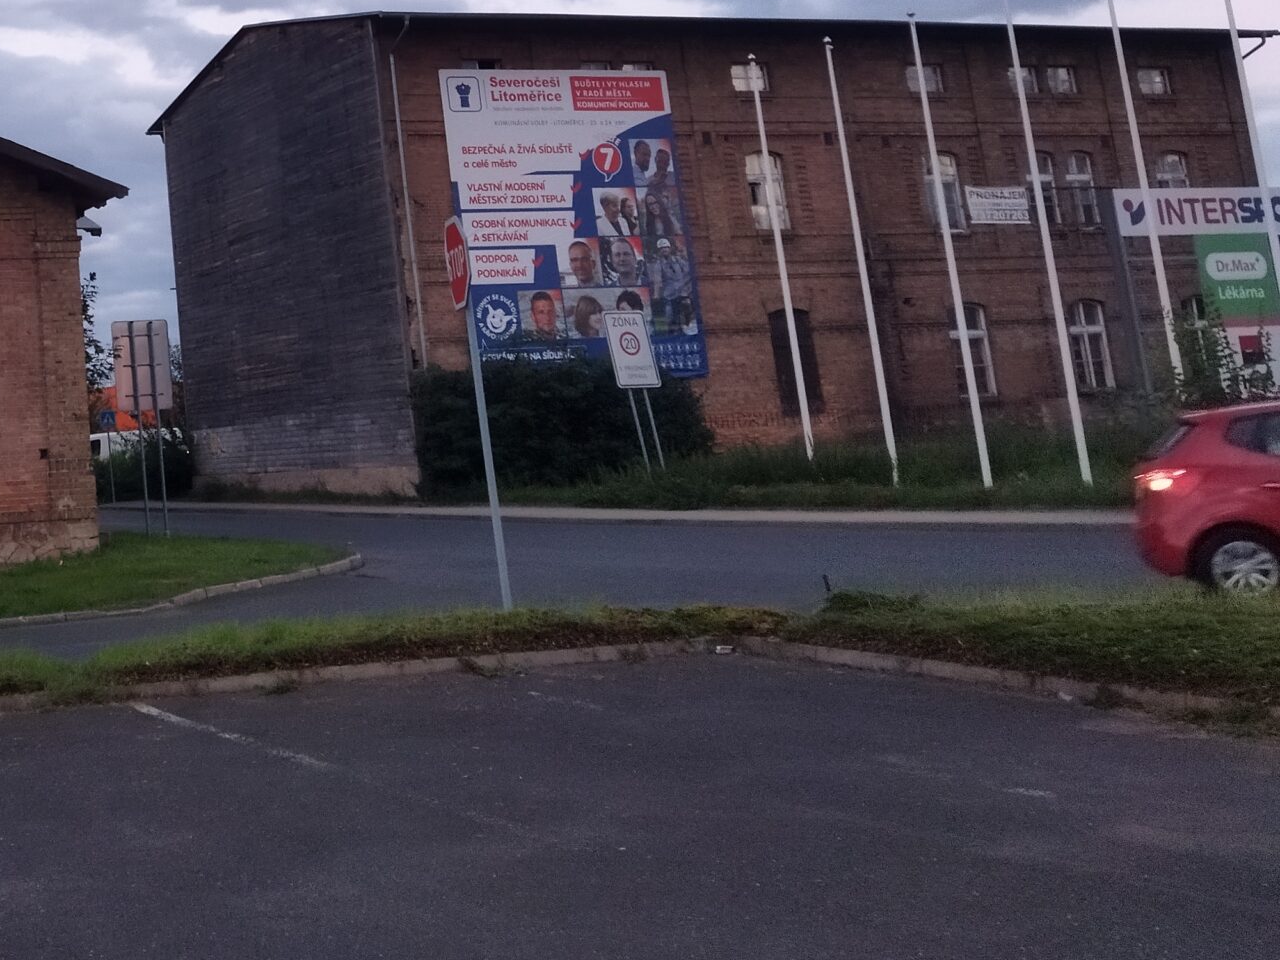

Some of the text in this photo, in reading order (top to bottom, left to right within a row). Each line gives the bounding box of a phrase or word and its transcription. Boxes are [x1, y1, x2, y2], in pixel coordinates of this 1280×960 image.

[489, 76, 560, 88] Severočeši
[491, 90, 562, 102] Litoměřice
[606, 88, 632, 97] MĚSTA
[577, 100, 650, 109] KOMUNITNÍ POLITIKA
[461, 143, 573, 155] BEZPEČNÁ A ŽIVÁ SÍDLIŠTĚ
[472, 159, 489, 168] celé
[491, 159, 518, 168] město
[600, 147, 614, 171] 7
[467, 180, 546, 192] VLASTNÍ MODERNÍ
[469, 193, 567, 205] MĚSTSKÝ ZDROJ TEPLA
[471, 217, 567, 229] OSOBNÍ KOMUNIKACE
[473, 231, 529, 242] A SETKÁVÁNÍ
[475, 254, 519, 264] PODPORA
[477, 266, 528, 278] PODNIKÁNÍ
[1216, 259, 1257, 273] Dr.Max
[1218, 286, 1266, 300] Lékárna
[624, 338, 637, 350] 20
